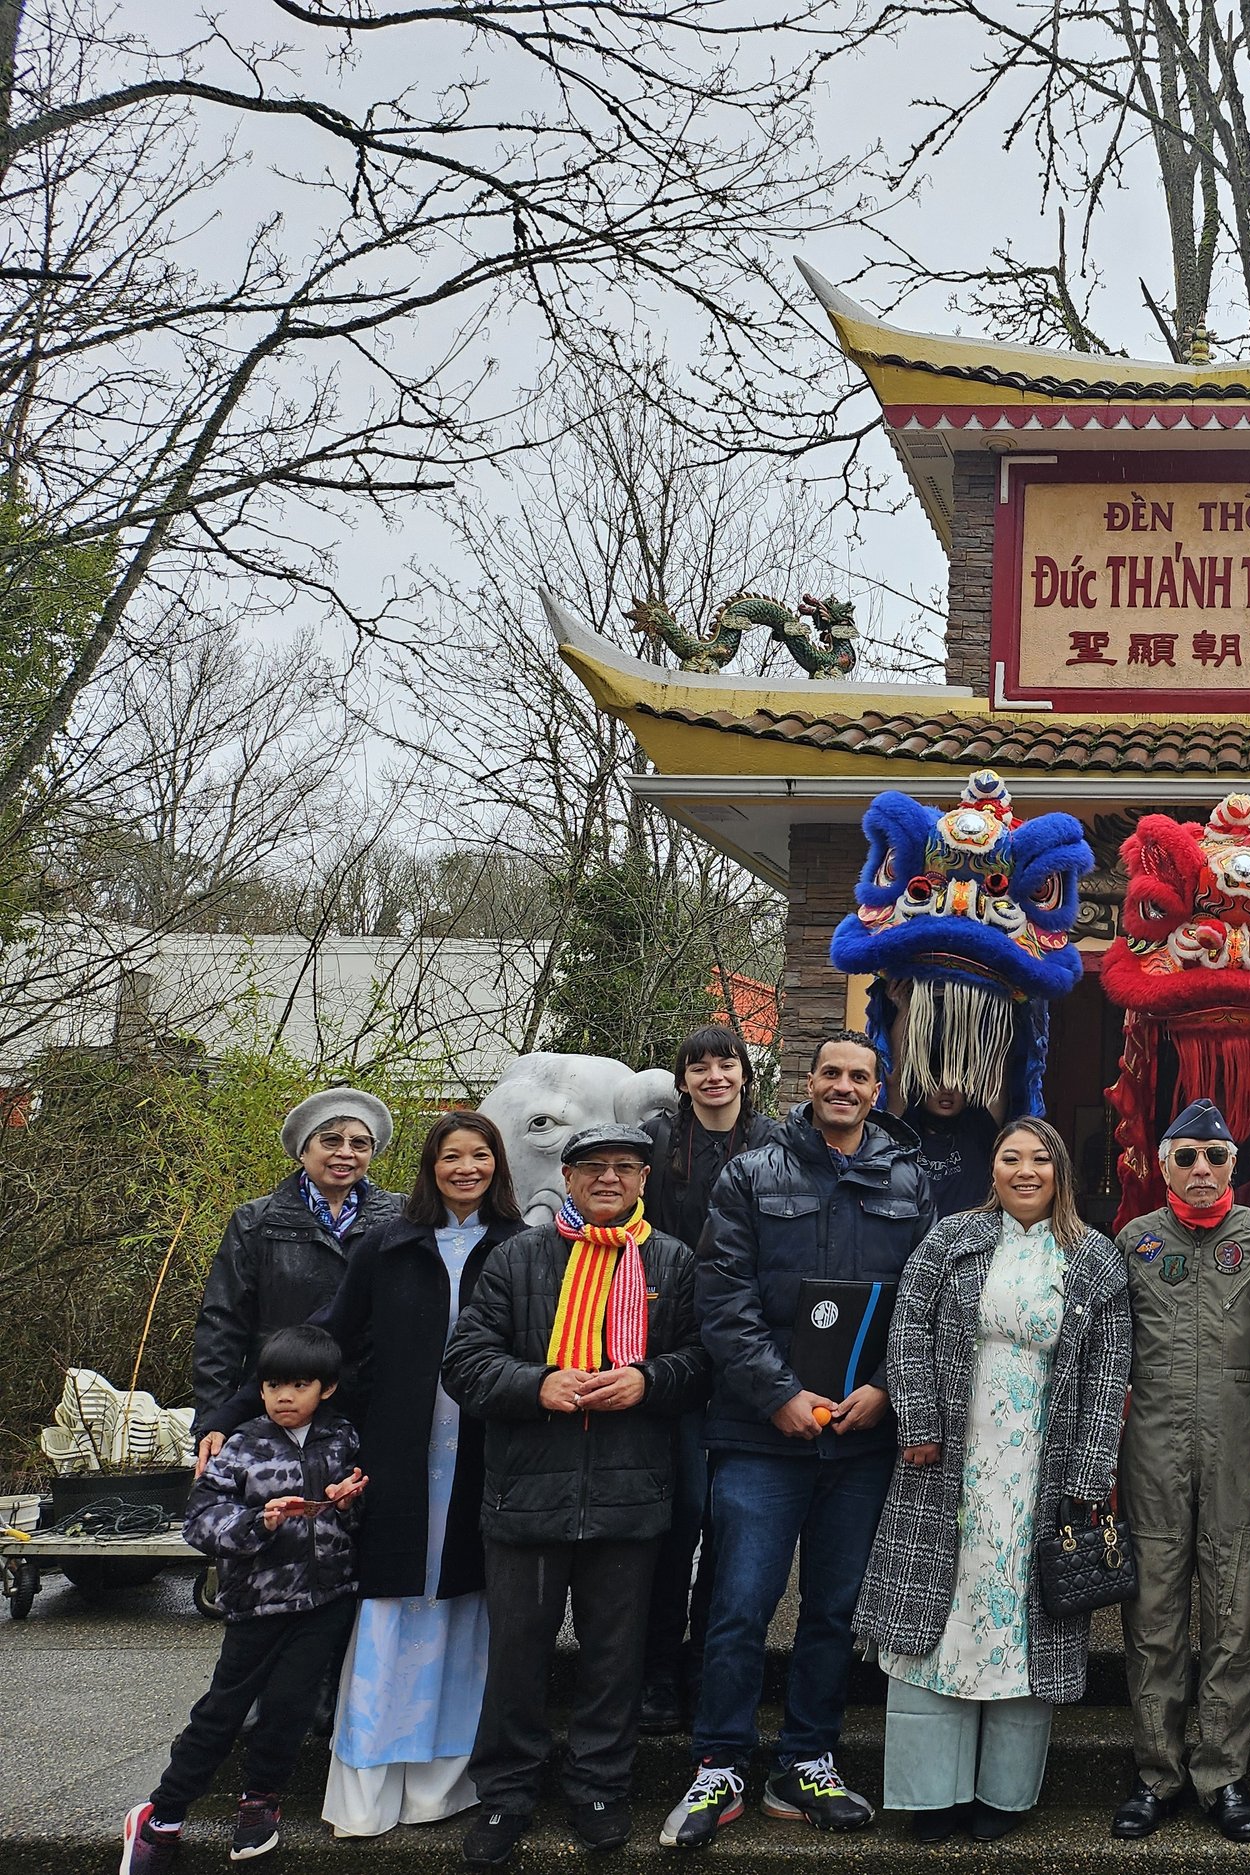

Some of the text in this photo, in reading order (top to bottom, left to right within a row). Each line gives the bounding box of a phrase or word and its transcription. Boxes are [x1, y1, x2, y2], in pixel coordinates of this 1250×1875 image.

[1103, 490, 1174, 532] ĐỀN
[1031, 554, 1098, 609] Đức
[1106, 541, 1233, 610] THÁNH
